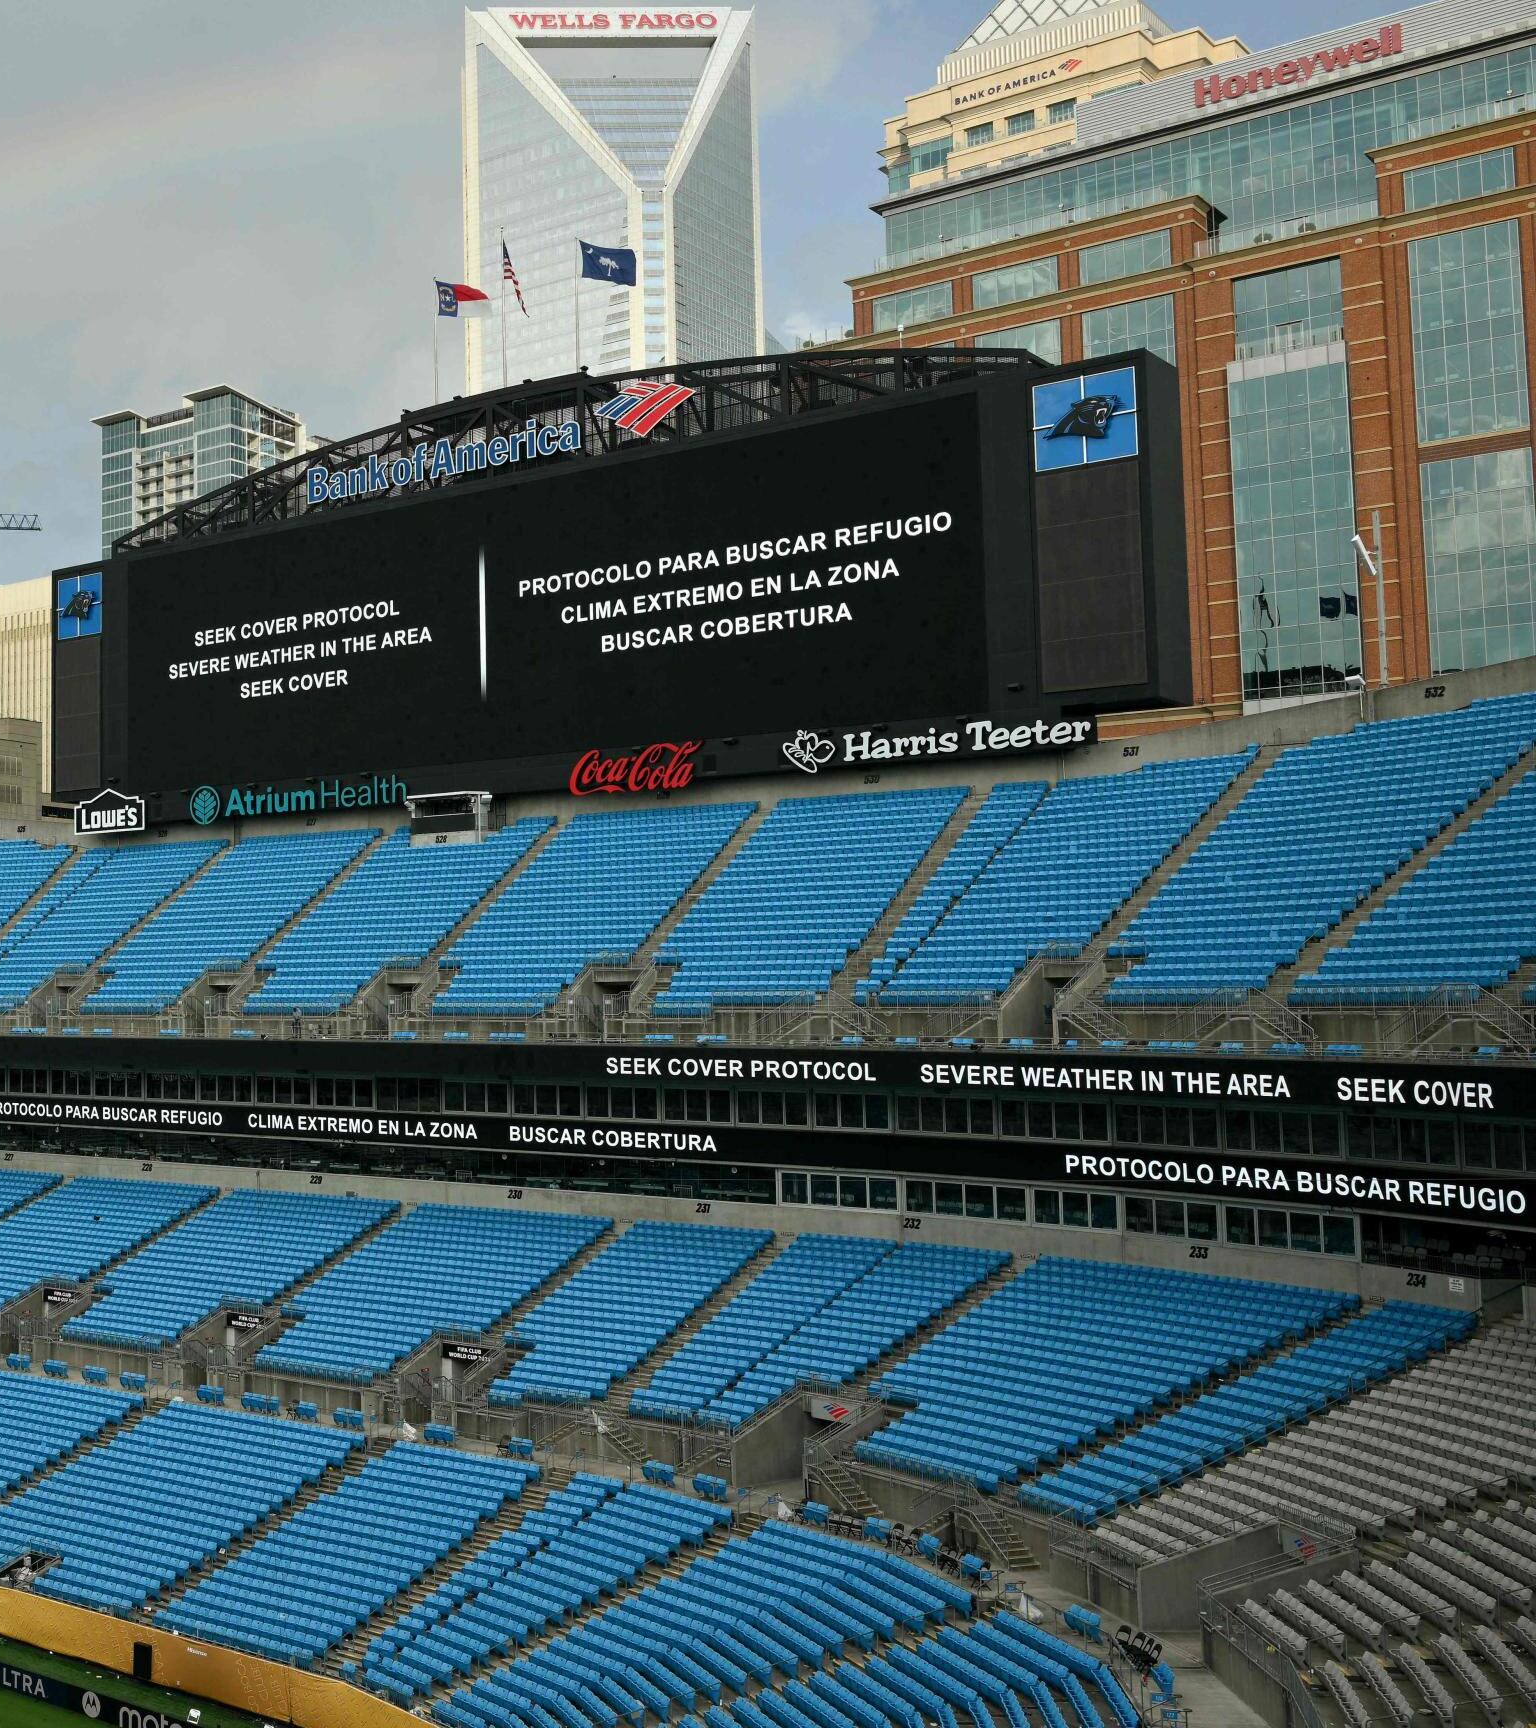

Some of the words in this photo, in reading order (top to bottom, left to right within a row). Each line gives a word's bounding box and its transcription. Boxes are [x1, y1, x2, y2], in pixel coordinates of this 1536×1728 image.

[509, 13, 610, 30] WELLS
[618, 13, 718, 30] FARGO
[1193, 23, 1404, 108] Honeywell
[954, 90, 985, 106] BANK
[987, 85, 1002, 96] OF
[1004, 69, 1057, 91] AMERICA
[307, 454, 389, 504] Bank
[392, 443, 427, 486] of
[430, 418, 581, 479] America
[518, 560, 652, 598] PROTOCOLO
[658, 549, 720, 576] PARA
[726, 531, 827, 565] BUSCAR
[834, 511, 952, 548] REFUGIO
[561, 598, 628, 624] CLIMA
[633, 581, 743, 615] EXTREMO
[750, 574, 782, 598] EN
[790, 569, 822, 592] LA
[827, 558, 900, 587] ZONA
[194, 625, 237, 647] SEEK
[240, 615, 298, 639] COVER
[302, 599, 400, 630] PROTOCOL
[601, 623, 694, 653] BUSCAR
[700, 602, 853, 640] COBERTURA
[168, 656, 231, 680] SEVERE
[234, 643, 316, 670] WEATHER
[320, 639, 337, 658] IN
[341, 633, 377, 654] THE
[380, 626, 433, 649] AREA
[240, 677, 284, 699] SEEK
[288, 669, 349, 692] COVER
[1424, 685, 1446, 699] 532
[843, 727, 958, 762] Harris
[966, 719, 1091, 751] Teeter
[1123, 746, 1140, 757] 531
[569, 740, 704, 796] Coca-Cola
[225, 786, 314, 817] Atrium
[320, 774, 407, 808] Health
[81, 804, 138, 830] LOWE'S
[435, 835, 448, 844] 528
[606, 1057, 662, 1076] SEEK
[667, 1058, 744, 1078] COVER
[750, 1060, 877, 1082] PROTOCOL
[920, 1063, 1015, 1086] SEVERE
[1020, 1066, 1134, 1091] WEATHER
[1141, 1070, 1164, 1092] IN
[1171, 1071, 1221, 1095] THE
[1226, 1073, 1291, 1098] AREA
[1337, 1077, 1406, 1104] SEEK
[1413, 1080, 1494, 1109] COVER
[65, 1104, 100, 1120] PARA
[102, 1106, 158, 1123] BUSCAR
[160, 1109, 223, 1126] REFUGIO
[247, 1113, 295, 1130] CLIMA
[297, 1115, 373, 1134] EXTREMO
[378, 1119, 399, 1136] EN
[404, 1120, 426, 1137] LA
[429, 1122, 478, 1140] ZONA
[509, 1125, 587, 1146] BUSCAR
[591, 1129, 717, 1152] COBERTURA
[4, 1153, 14, 1161] 227
[310, 1175, 323, 1184] 229
[1065, 1154, 1214, 1185] PROTOCOLO
[1221, 1165, 1290, 1191] PARA
[1296, 1171, 1402, 1202] BUSCAR
[1408, 1180, 1526, 1214] REFUGIO
[507, 1189, 522, 1200] 230
[696, 1203, 711, 1214] 231
[904, 1217, 922, 1230] 232
[1189, 1245, 1209, 1259] 233
[1406, 1272, 1427, 1289] 234
[468, 1347, 482, 1355] CLUB
[119, 1706, 184, 1728] mot
